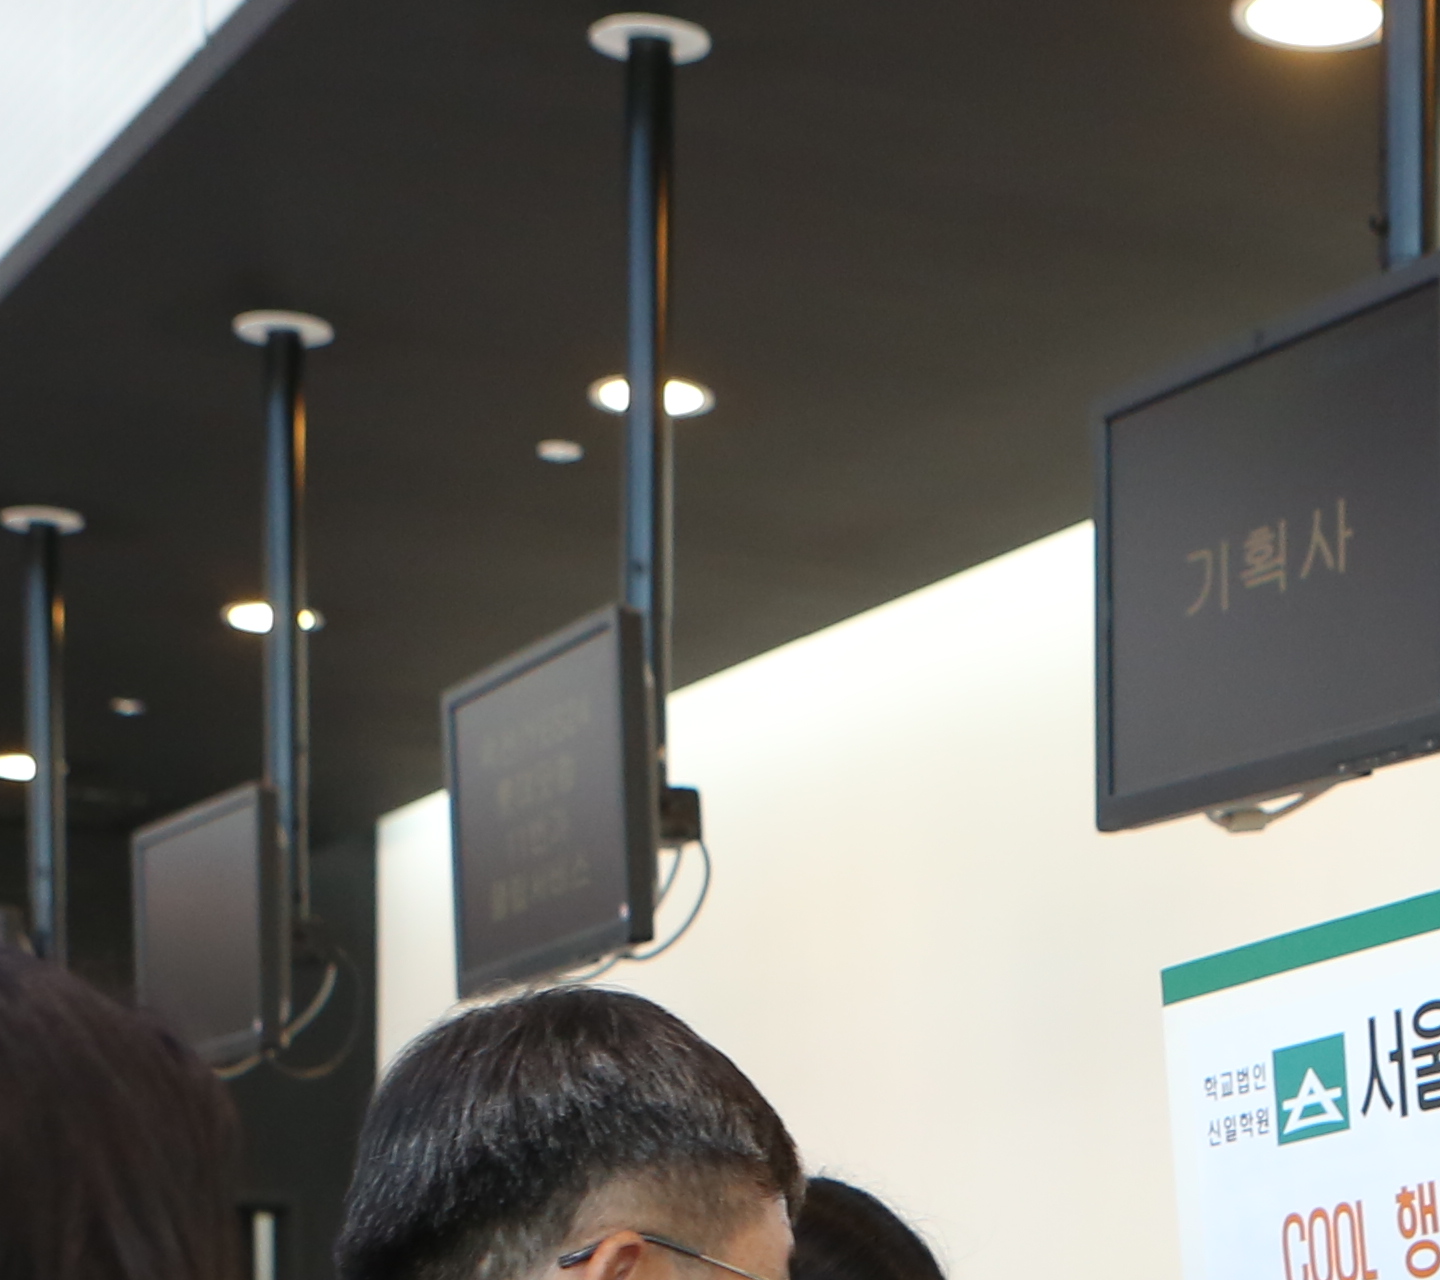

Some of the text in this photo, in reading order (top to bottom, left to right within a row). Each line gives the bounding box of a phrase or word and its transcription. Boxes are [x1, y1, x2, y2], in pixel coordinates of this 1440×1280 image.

[1185, 499, 1355, 617] 기획사
[1204, 1062, 1267, 1101] 학교법인
[1208, 1107, 1270, 1147] 신일학원
